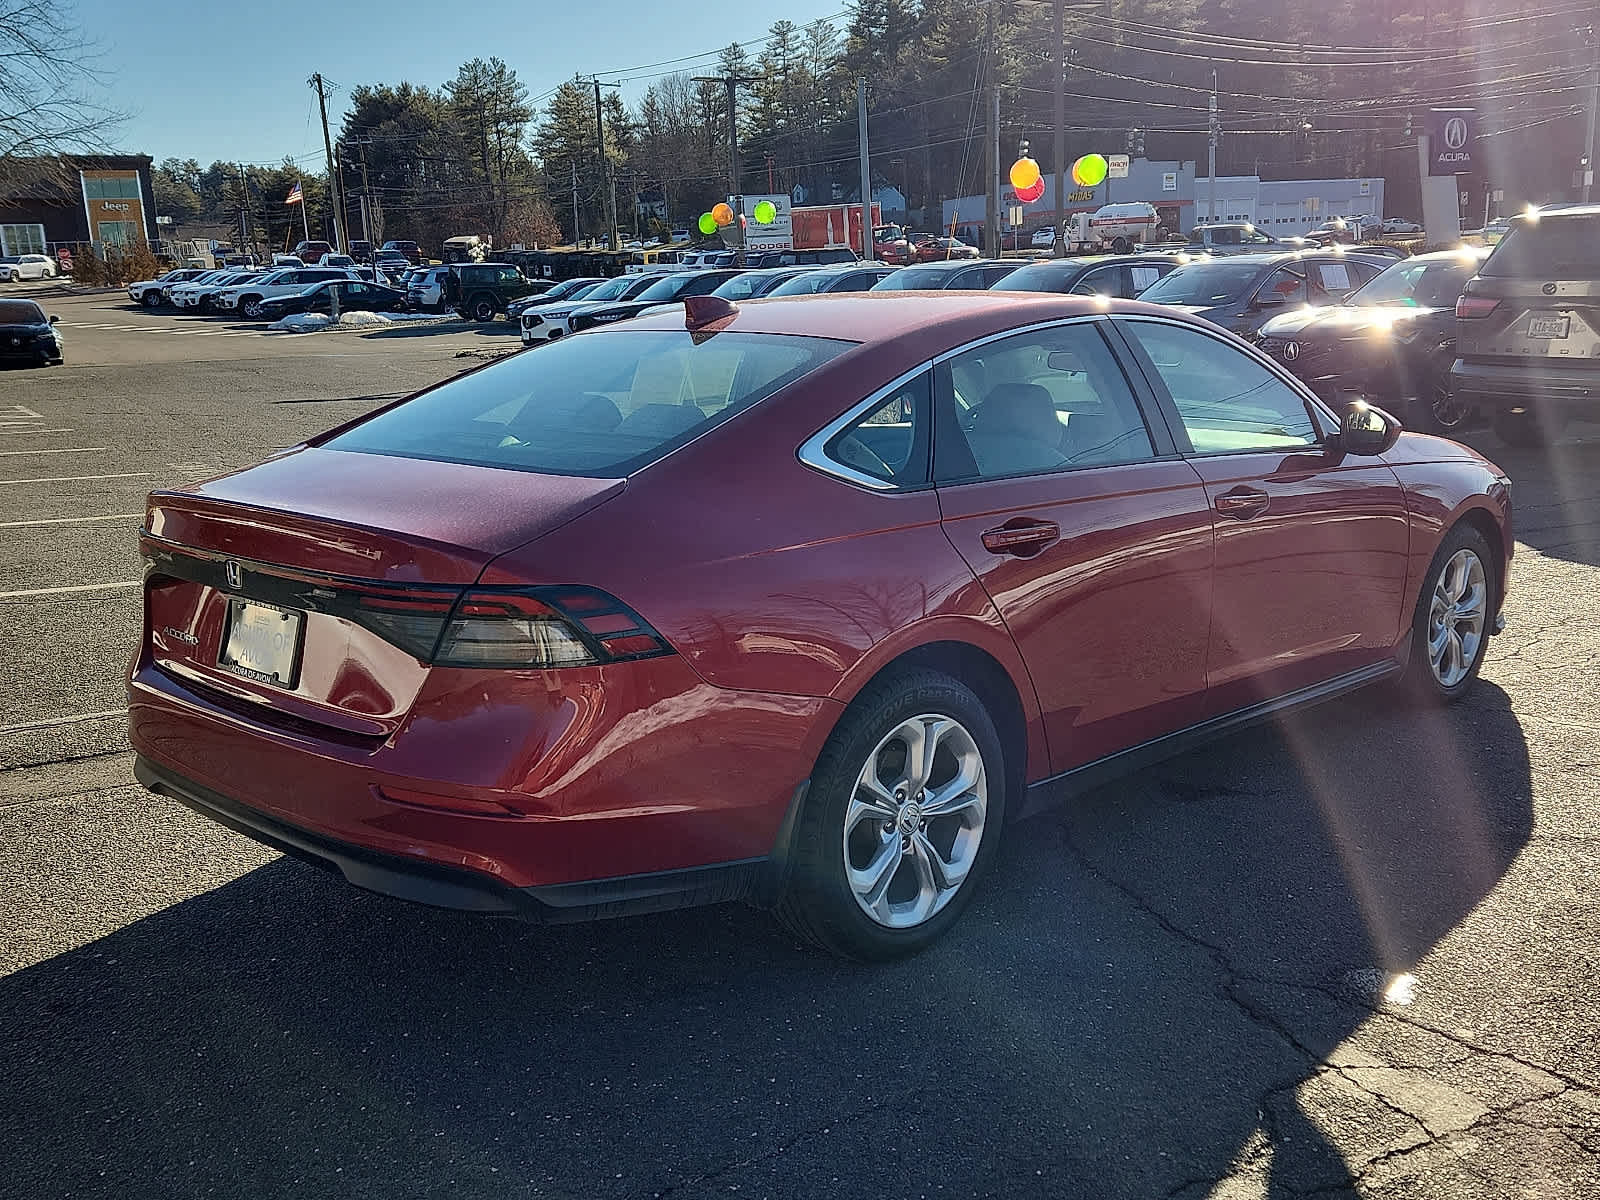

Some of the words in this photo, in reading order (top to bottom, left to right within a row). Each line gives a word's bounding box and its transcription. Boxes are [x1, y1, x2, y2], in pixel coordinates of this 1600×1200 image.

[1438, 152, 1471, 162] ACURA
[1068, 191, 1094, 202] MIDAS
[101, 201, 129, 212] Jeep
[750, 242, 791, 251] DODGE
[162, 626, 199, 646] ACCORD
[231, 665, 248, 678] ACURA
[255, 672, 272, 684] AVON
